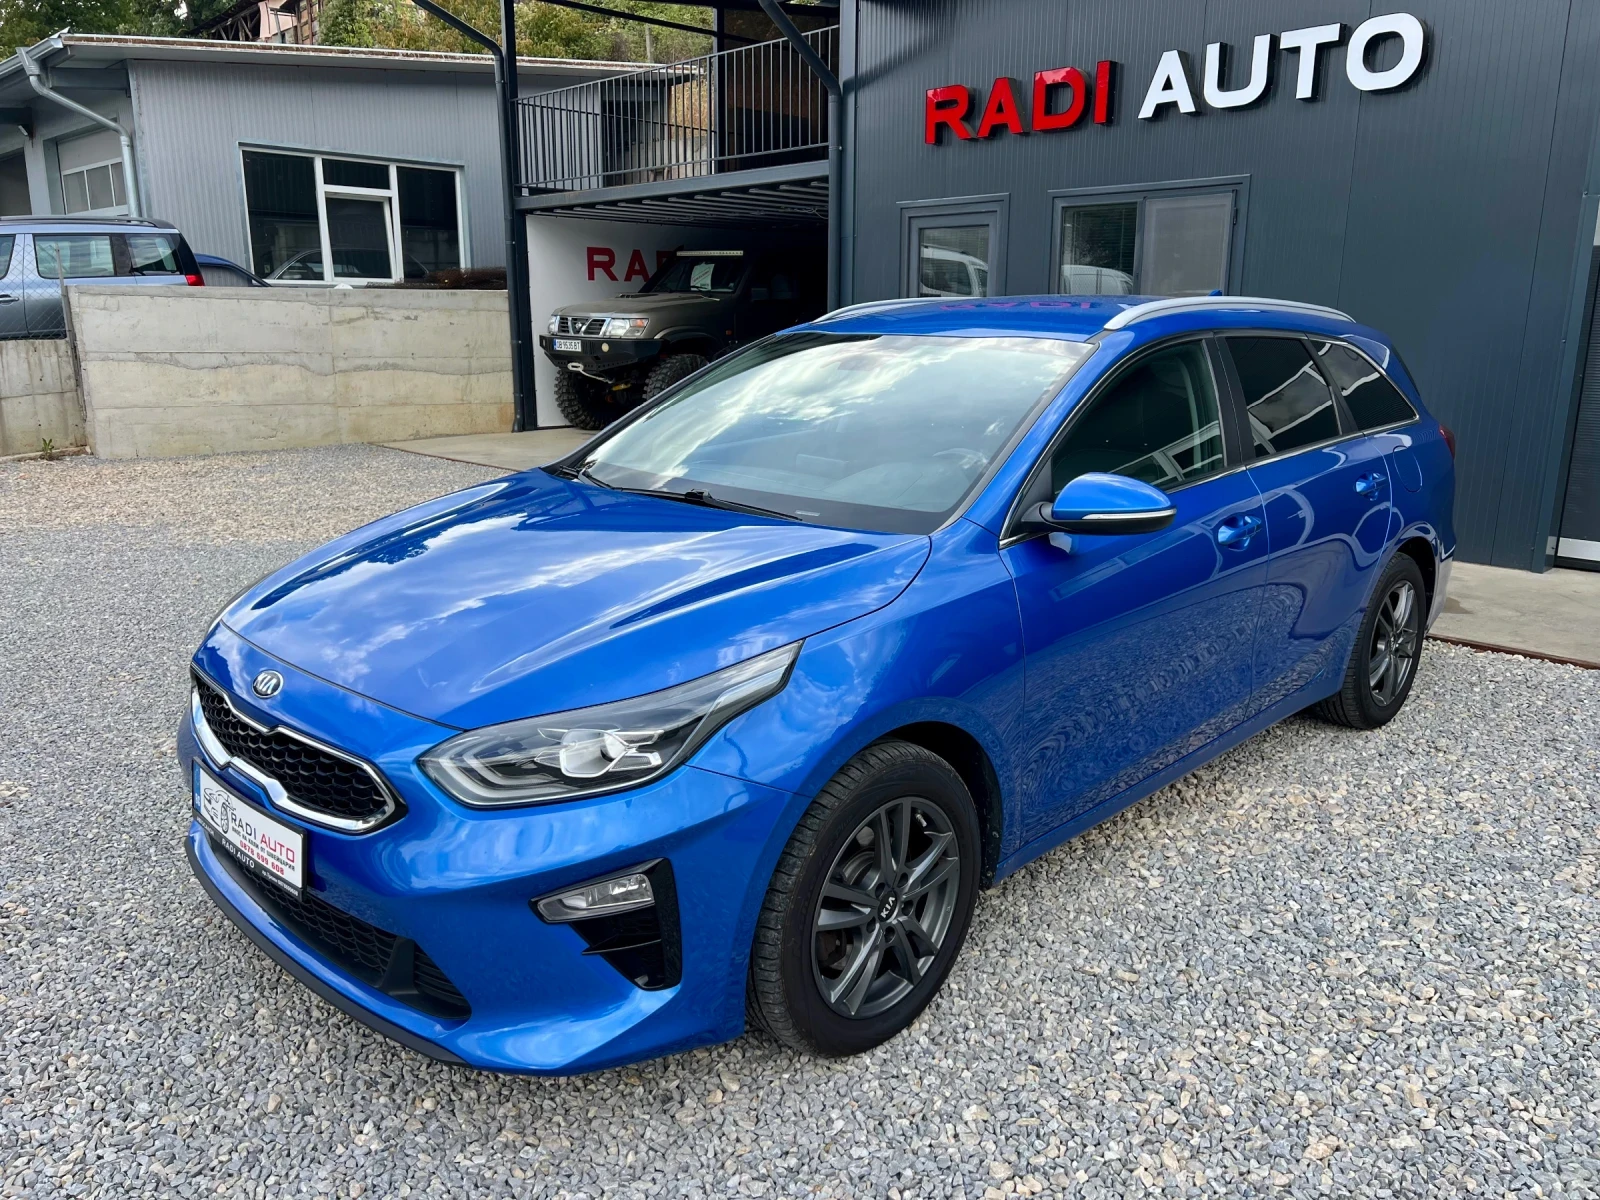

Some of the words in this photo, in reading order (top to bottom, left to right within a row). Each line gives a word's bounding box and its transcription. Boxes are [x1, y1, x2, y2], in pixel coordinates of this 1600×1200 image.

[924, 60, 1112, 144] RADI
[1138, 12, 1425, 119] AUTO
[254, 672, 277, 694] KIA
[221, 838, 236, 854] RADI
[236, 851, 255, 869] AUTO
[231, 811, 257, 840] RADI
[260, 833, 295, 863] AUTO
[239, 839, 255, 856] 0878
[256, 852, 269, 866] 699
[271, 861, 285, 876] 608
[880, 896, 896, 918] KIA
